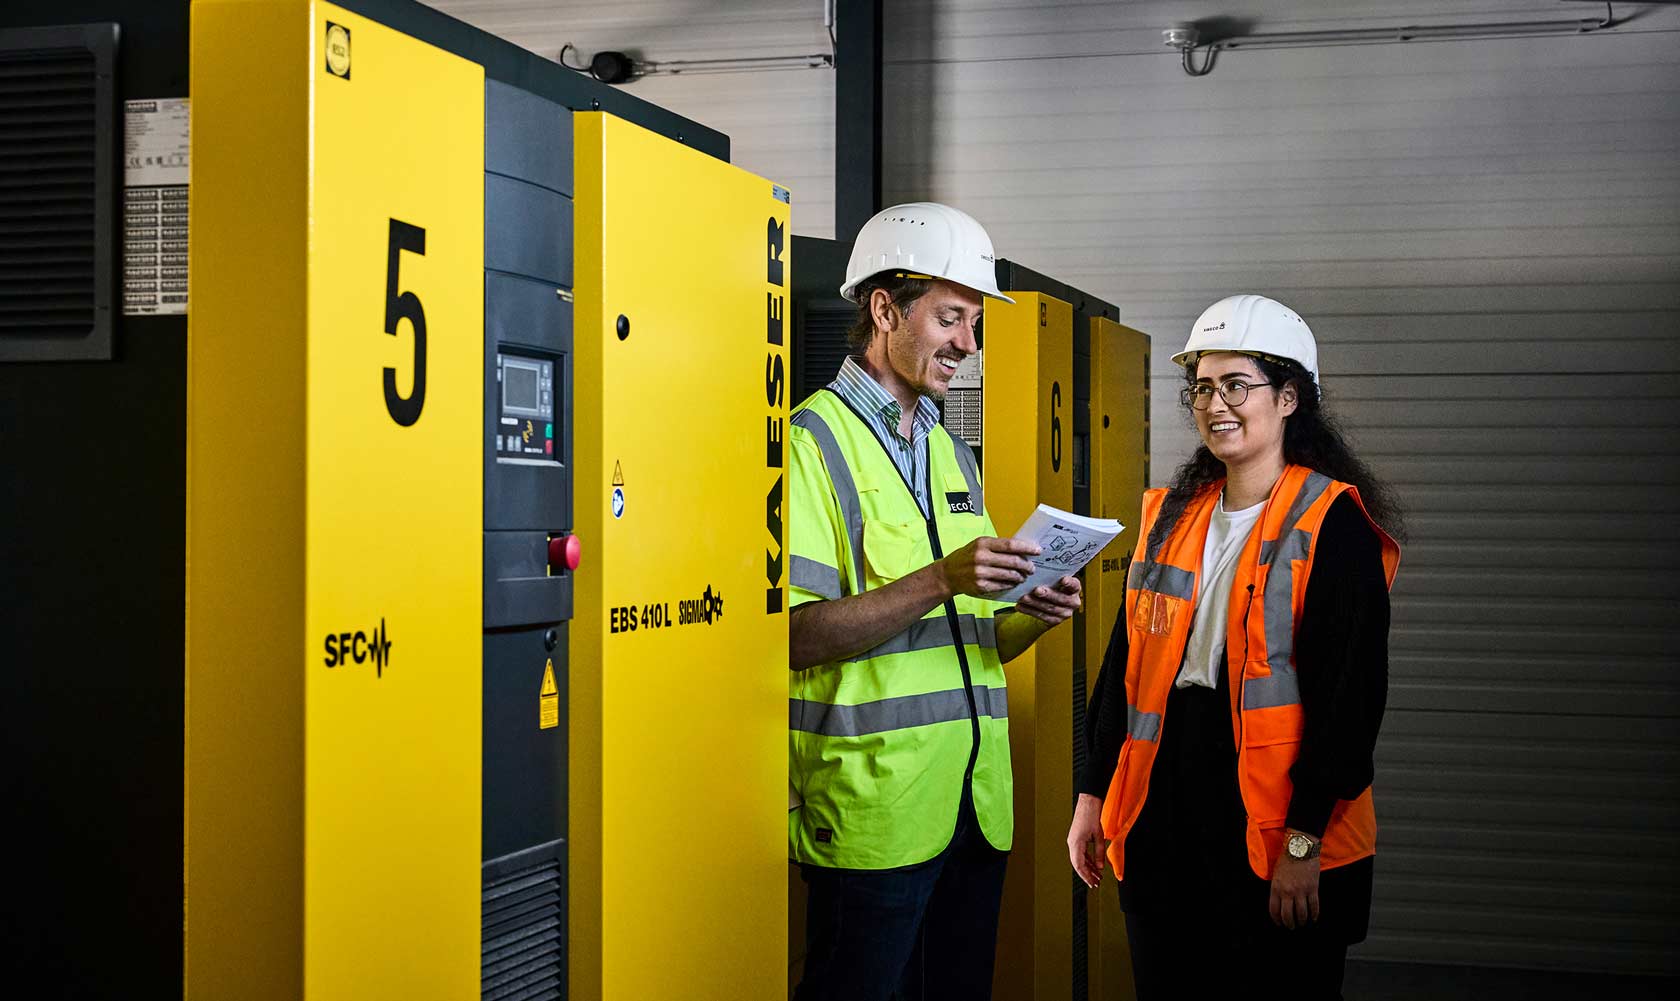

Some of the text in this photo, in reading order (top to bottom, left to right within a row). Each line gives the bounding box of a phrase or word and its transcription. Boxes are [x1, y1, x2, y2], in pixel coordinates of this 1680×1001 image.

[382, 217, 427, 427] 5
[766, 216, 785, 615] KAESER
[1052, 381, 1062, 473] 6
[950, 502, 968, 512] ECO
[610, 599, 705, 634] EBS 410 L SIGMA
[324, 630, 367, 669] SFC
